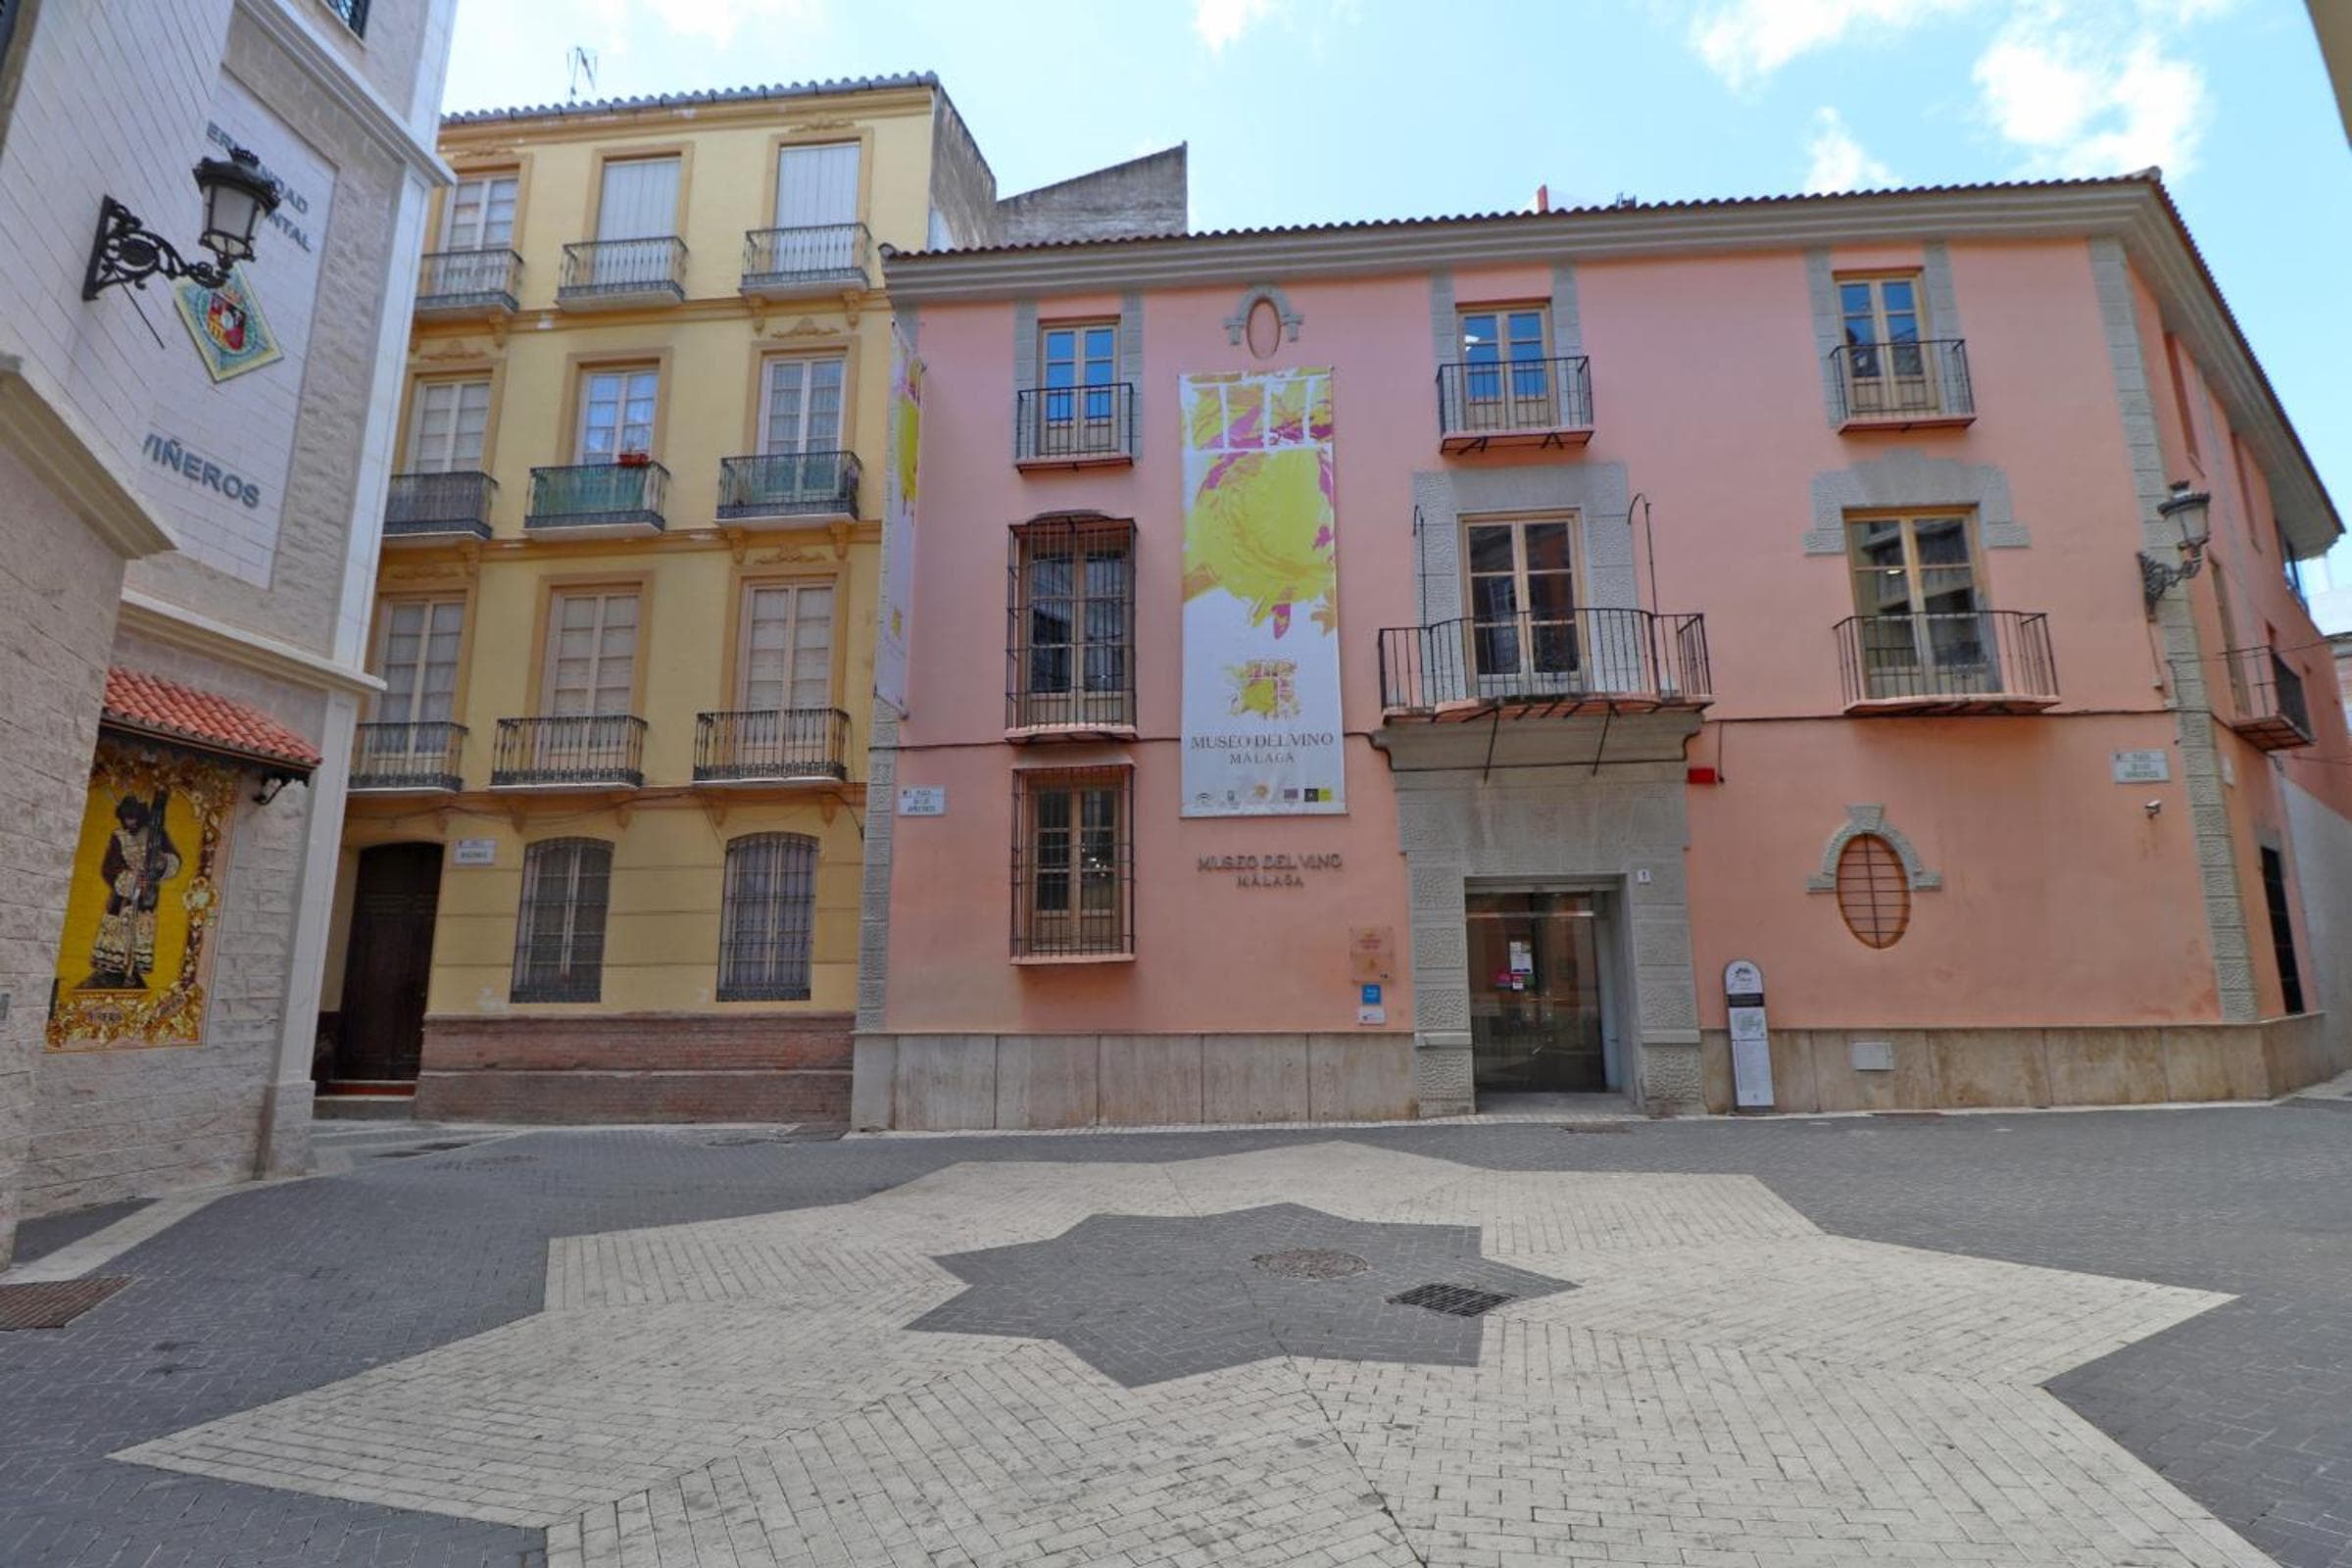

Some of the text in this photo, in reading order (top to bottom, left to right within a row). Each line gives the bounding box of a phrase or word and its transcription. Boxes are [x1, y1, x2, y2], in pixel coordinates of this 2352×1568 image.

[1192, 732, 1334, 750] MUSEO DEL VINO
[1198, 854, 1343, 871] MUSEO DEL VINO
